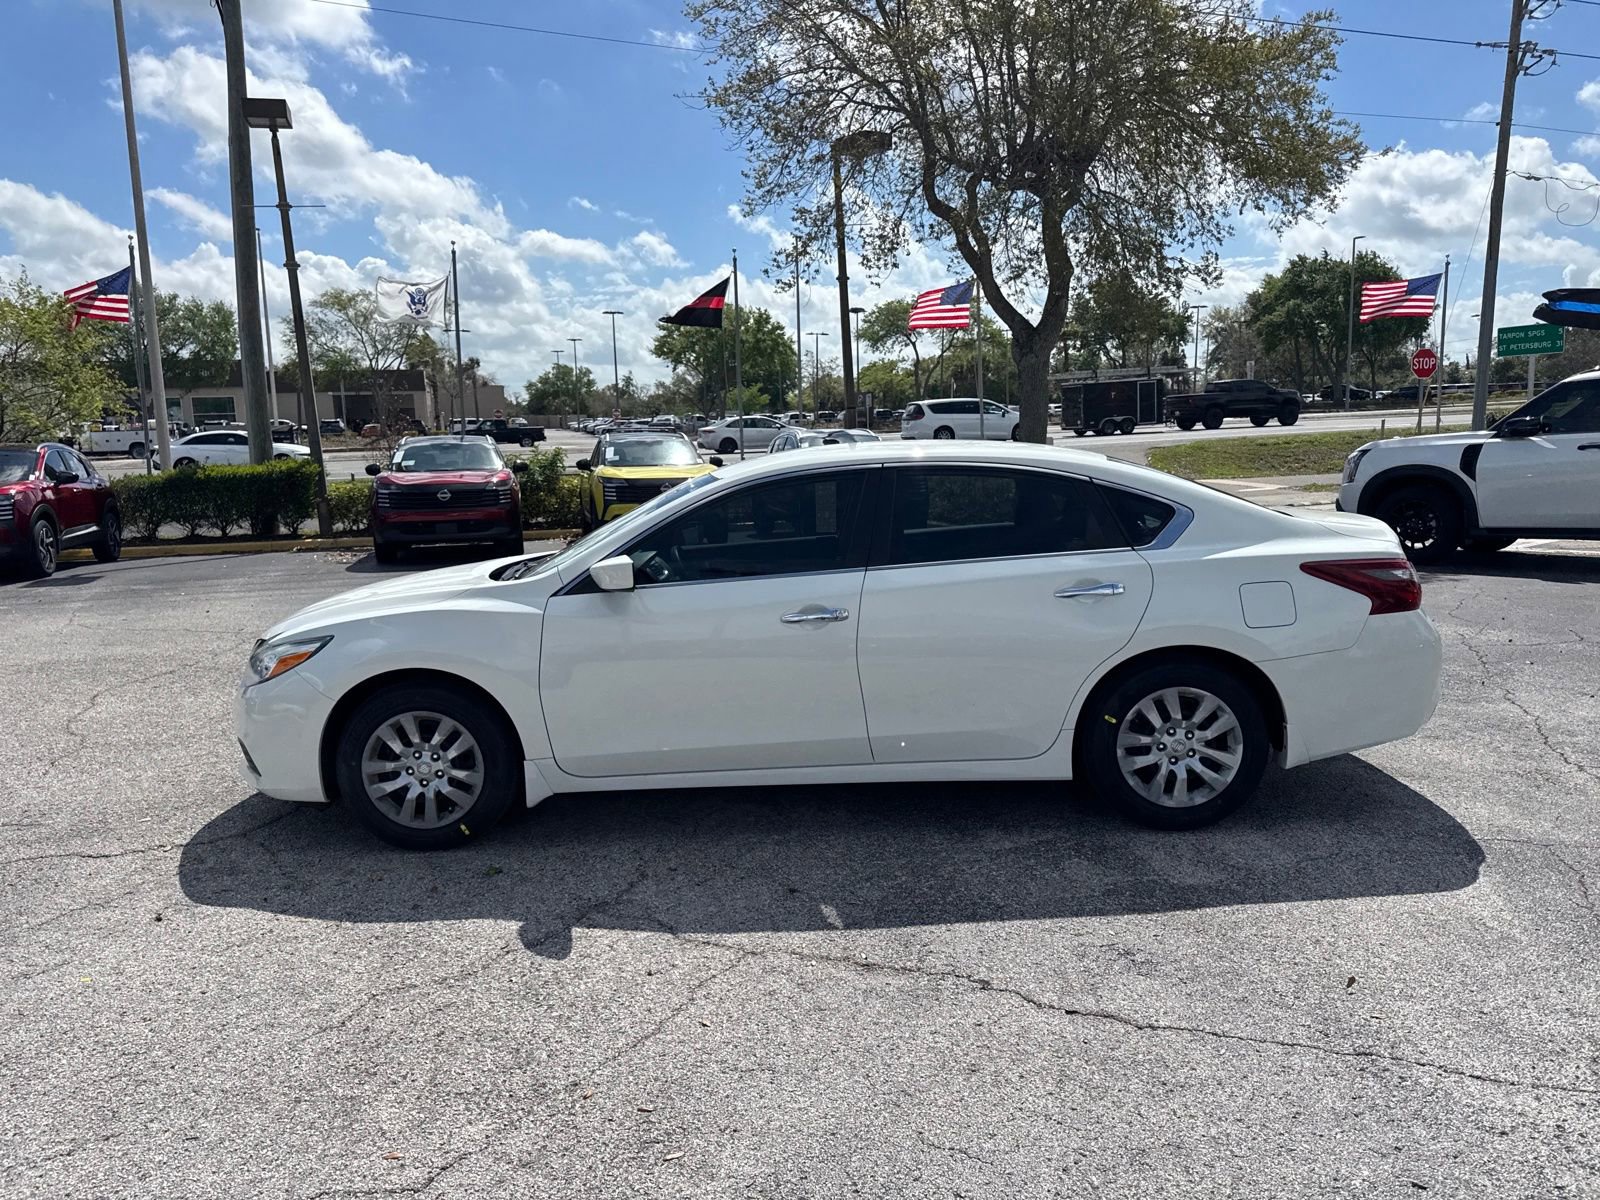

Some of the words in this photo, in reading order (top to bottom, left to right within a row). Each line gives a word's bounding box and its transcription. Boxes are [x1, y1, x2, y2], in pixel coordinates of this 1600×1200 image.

[1499, 331, 1525, 340] TARPON
[1527, 329, 1545, 338] SPGS
[1510, 341, 1552, 350] PETERSBURG
[1413, 357, 1436, 370] STOP
